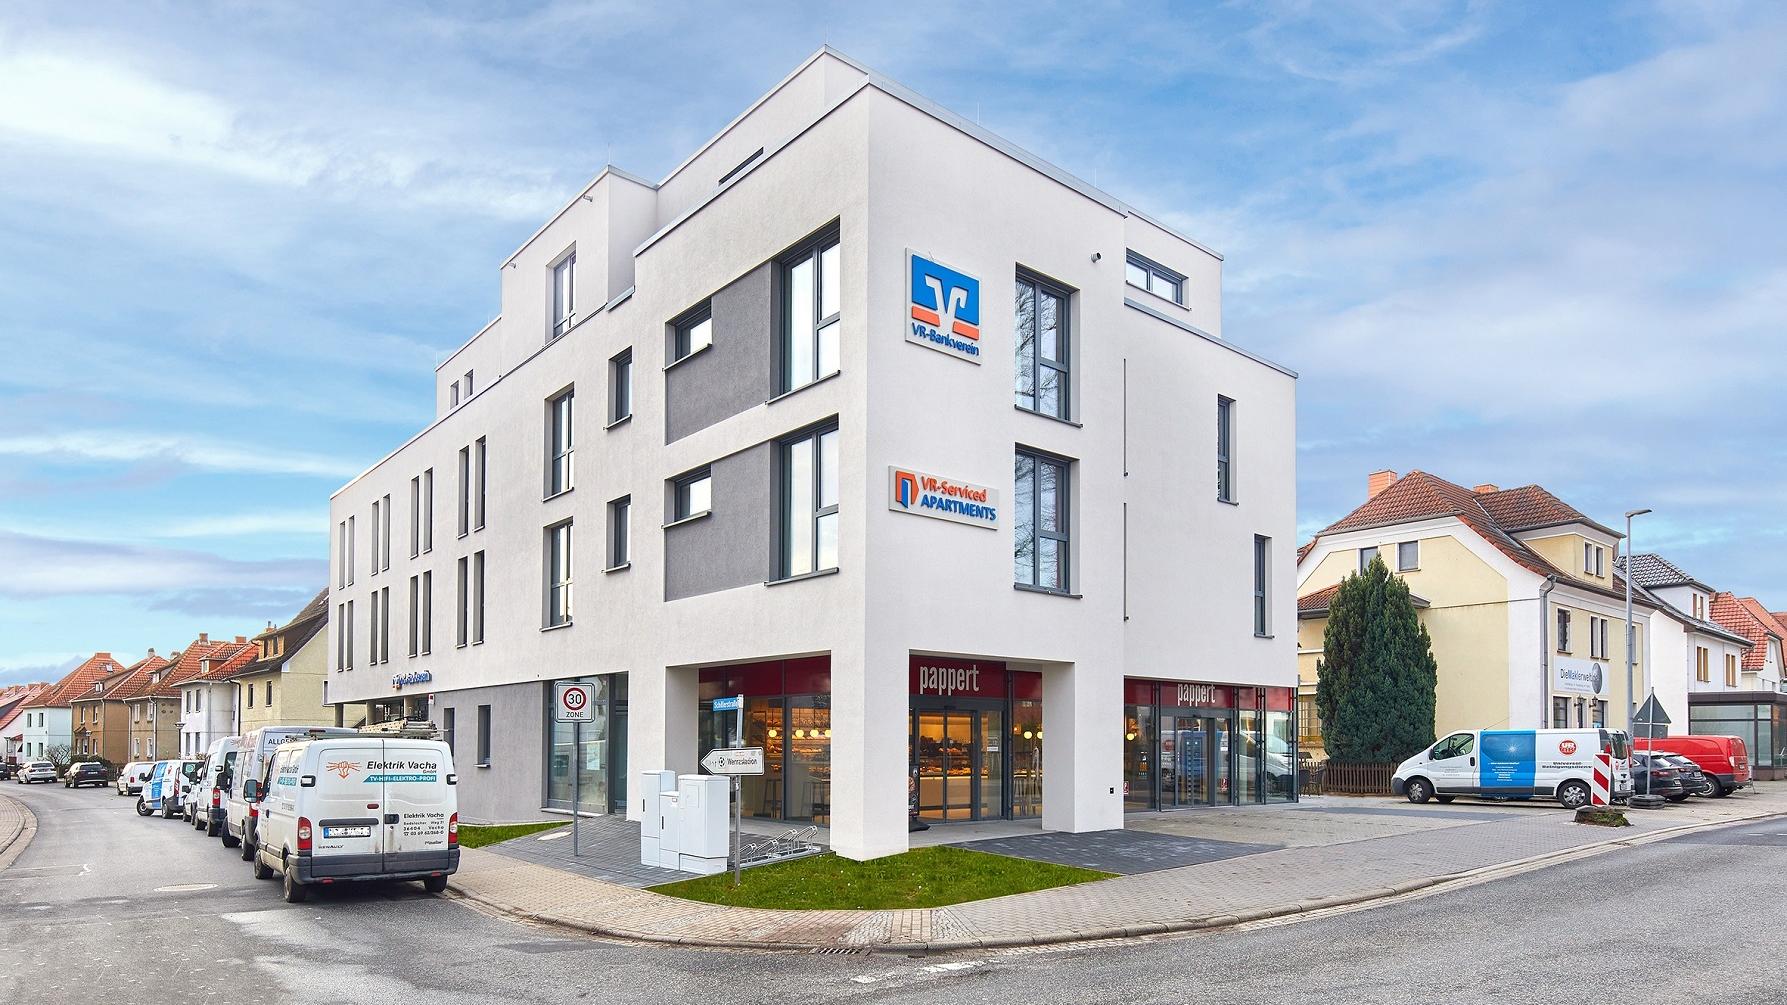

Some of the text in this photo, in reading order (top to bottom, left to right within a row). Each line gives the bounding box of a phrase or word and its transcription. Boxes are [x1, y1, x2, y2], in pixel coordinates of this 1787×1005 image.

[911, 322, 980, 356] VR-Bankverein
[921, 475, 987, 503] VR-Serviced
[920, 494, 997, 521] APARTMENTS
[919, 664, 980, 696] pappert
[568, 693, 582, 705] 30
[1177, 683, 1216, 707] pappert
[367, 761, 437, 770] Elektrik Vacha
